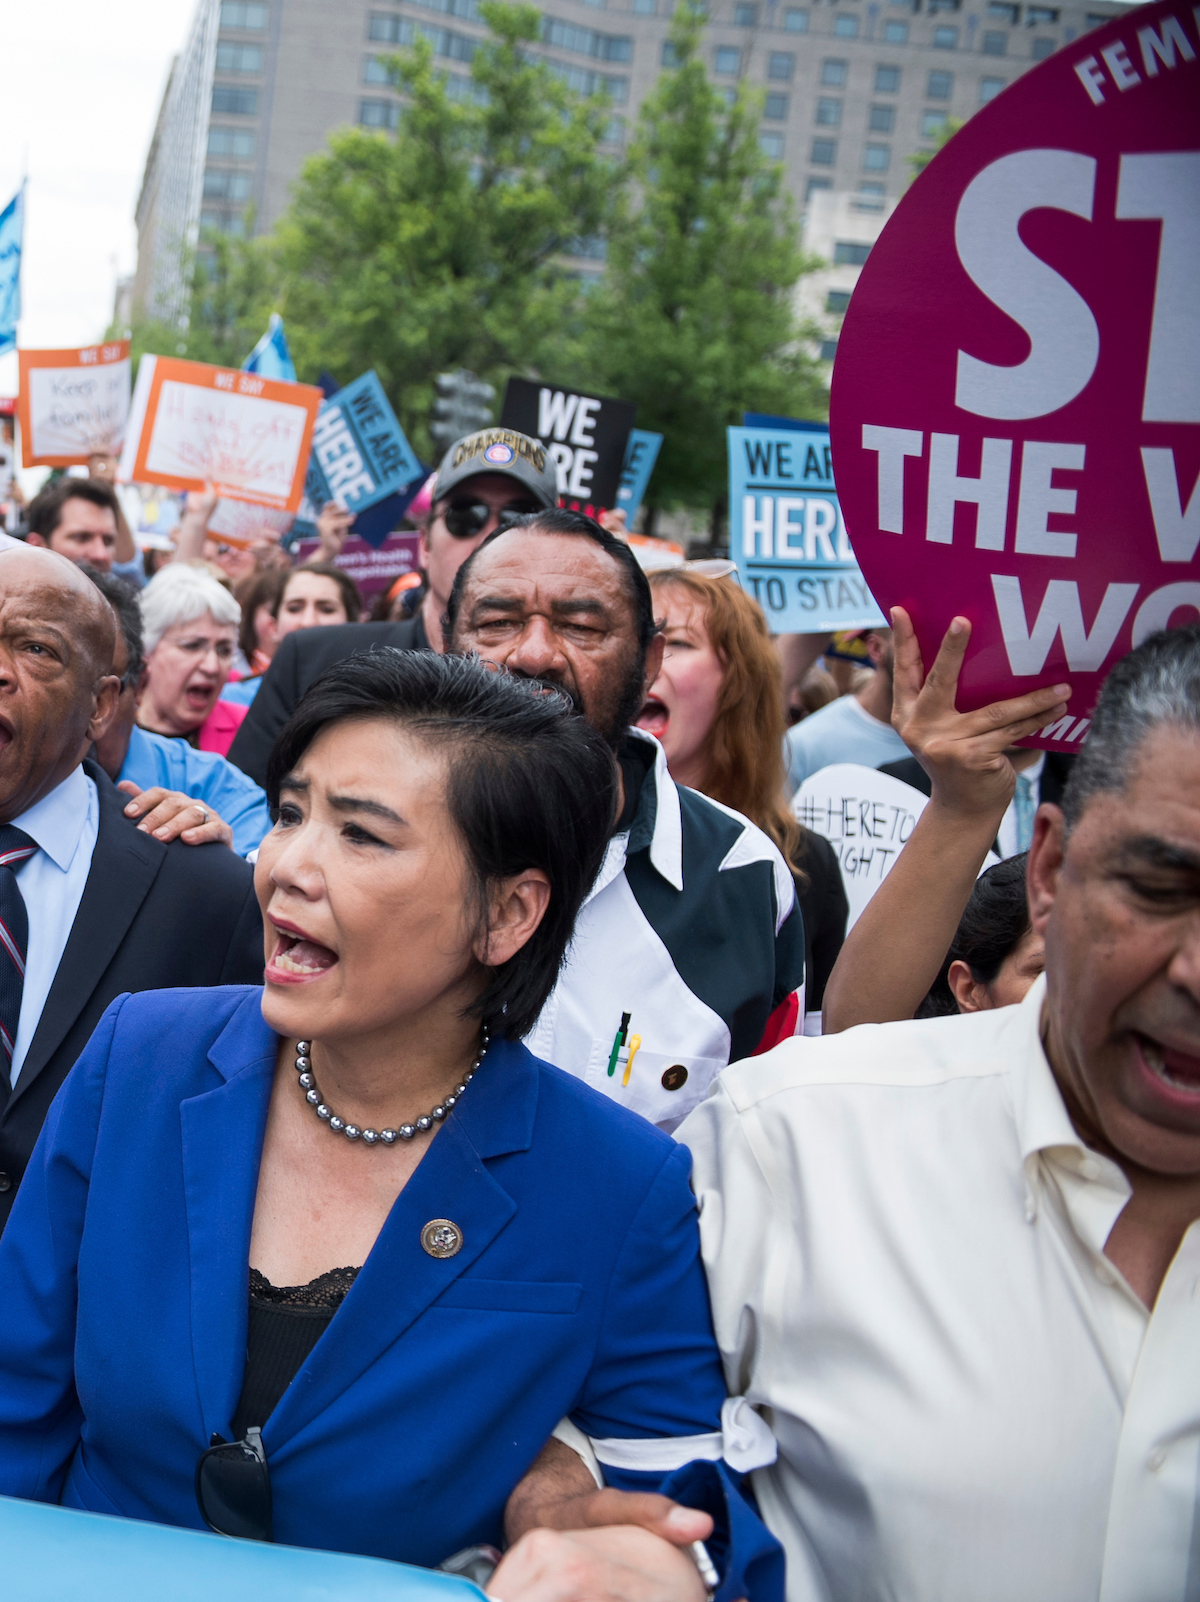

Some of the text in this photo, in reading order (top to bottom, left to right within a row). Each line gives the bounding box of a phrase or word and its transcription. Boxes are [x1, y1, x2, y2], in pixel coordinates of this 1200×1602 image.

[79, 346, 121, 364] WE SAY
[214, 372, 265, 395] WE SAY
[351, 383, 412, 482] WE ARE
[537, 387, 601, 447] WE
[315, 405, 376, 510] HERE
[548, 441, 599, 498] RE
[744, 438, 793, 479] WE
[861, 423, 1086, 558] THE
[749, 576, 870, 612] TO STAY
[829, 838, 895, 880] IGHT
